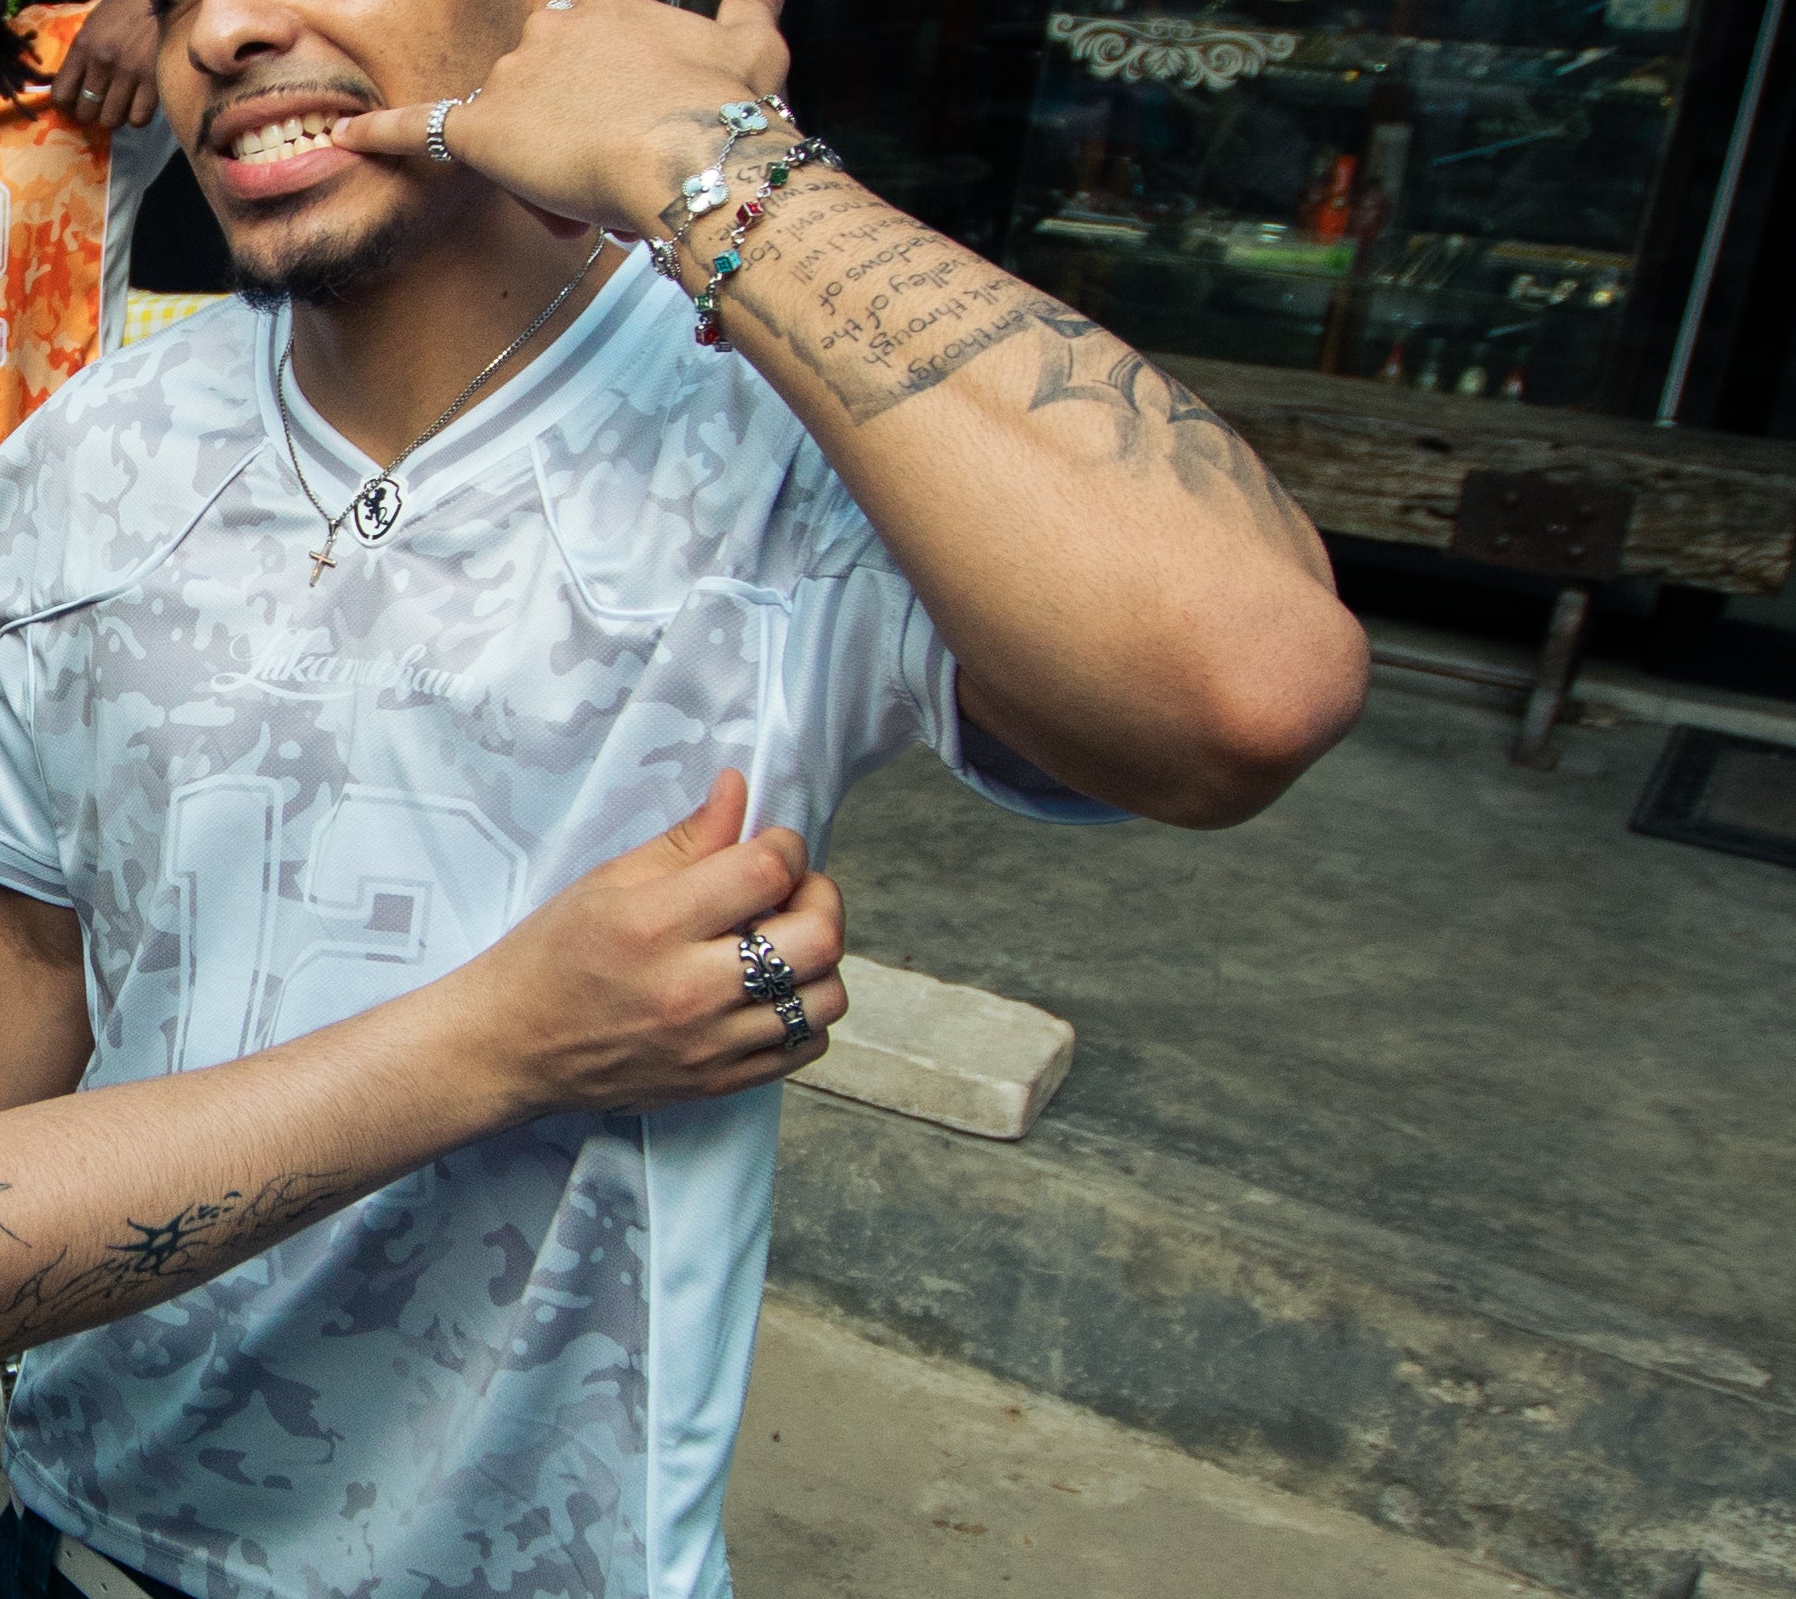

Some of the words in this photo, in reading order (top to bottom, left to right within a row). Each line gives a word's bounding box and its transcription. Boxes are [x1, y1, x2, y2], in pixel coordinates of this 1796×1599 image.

[744, 239, 781, 269] for
[789, 248, 825, 283] will
[888, 259, 966, 293] valley
[818, 279, 843, 317] of
[864, 294, 891, 330] of
[819, 318, 863, 351] the
[862, 298, 966, 367] through
[170, 772, 530, 1073] 12
